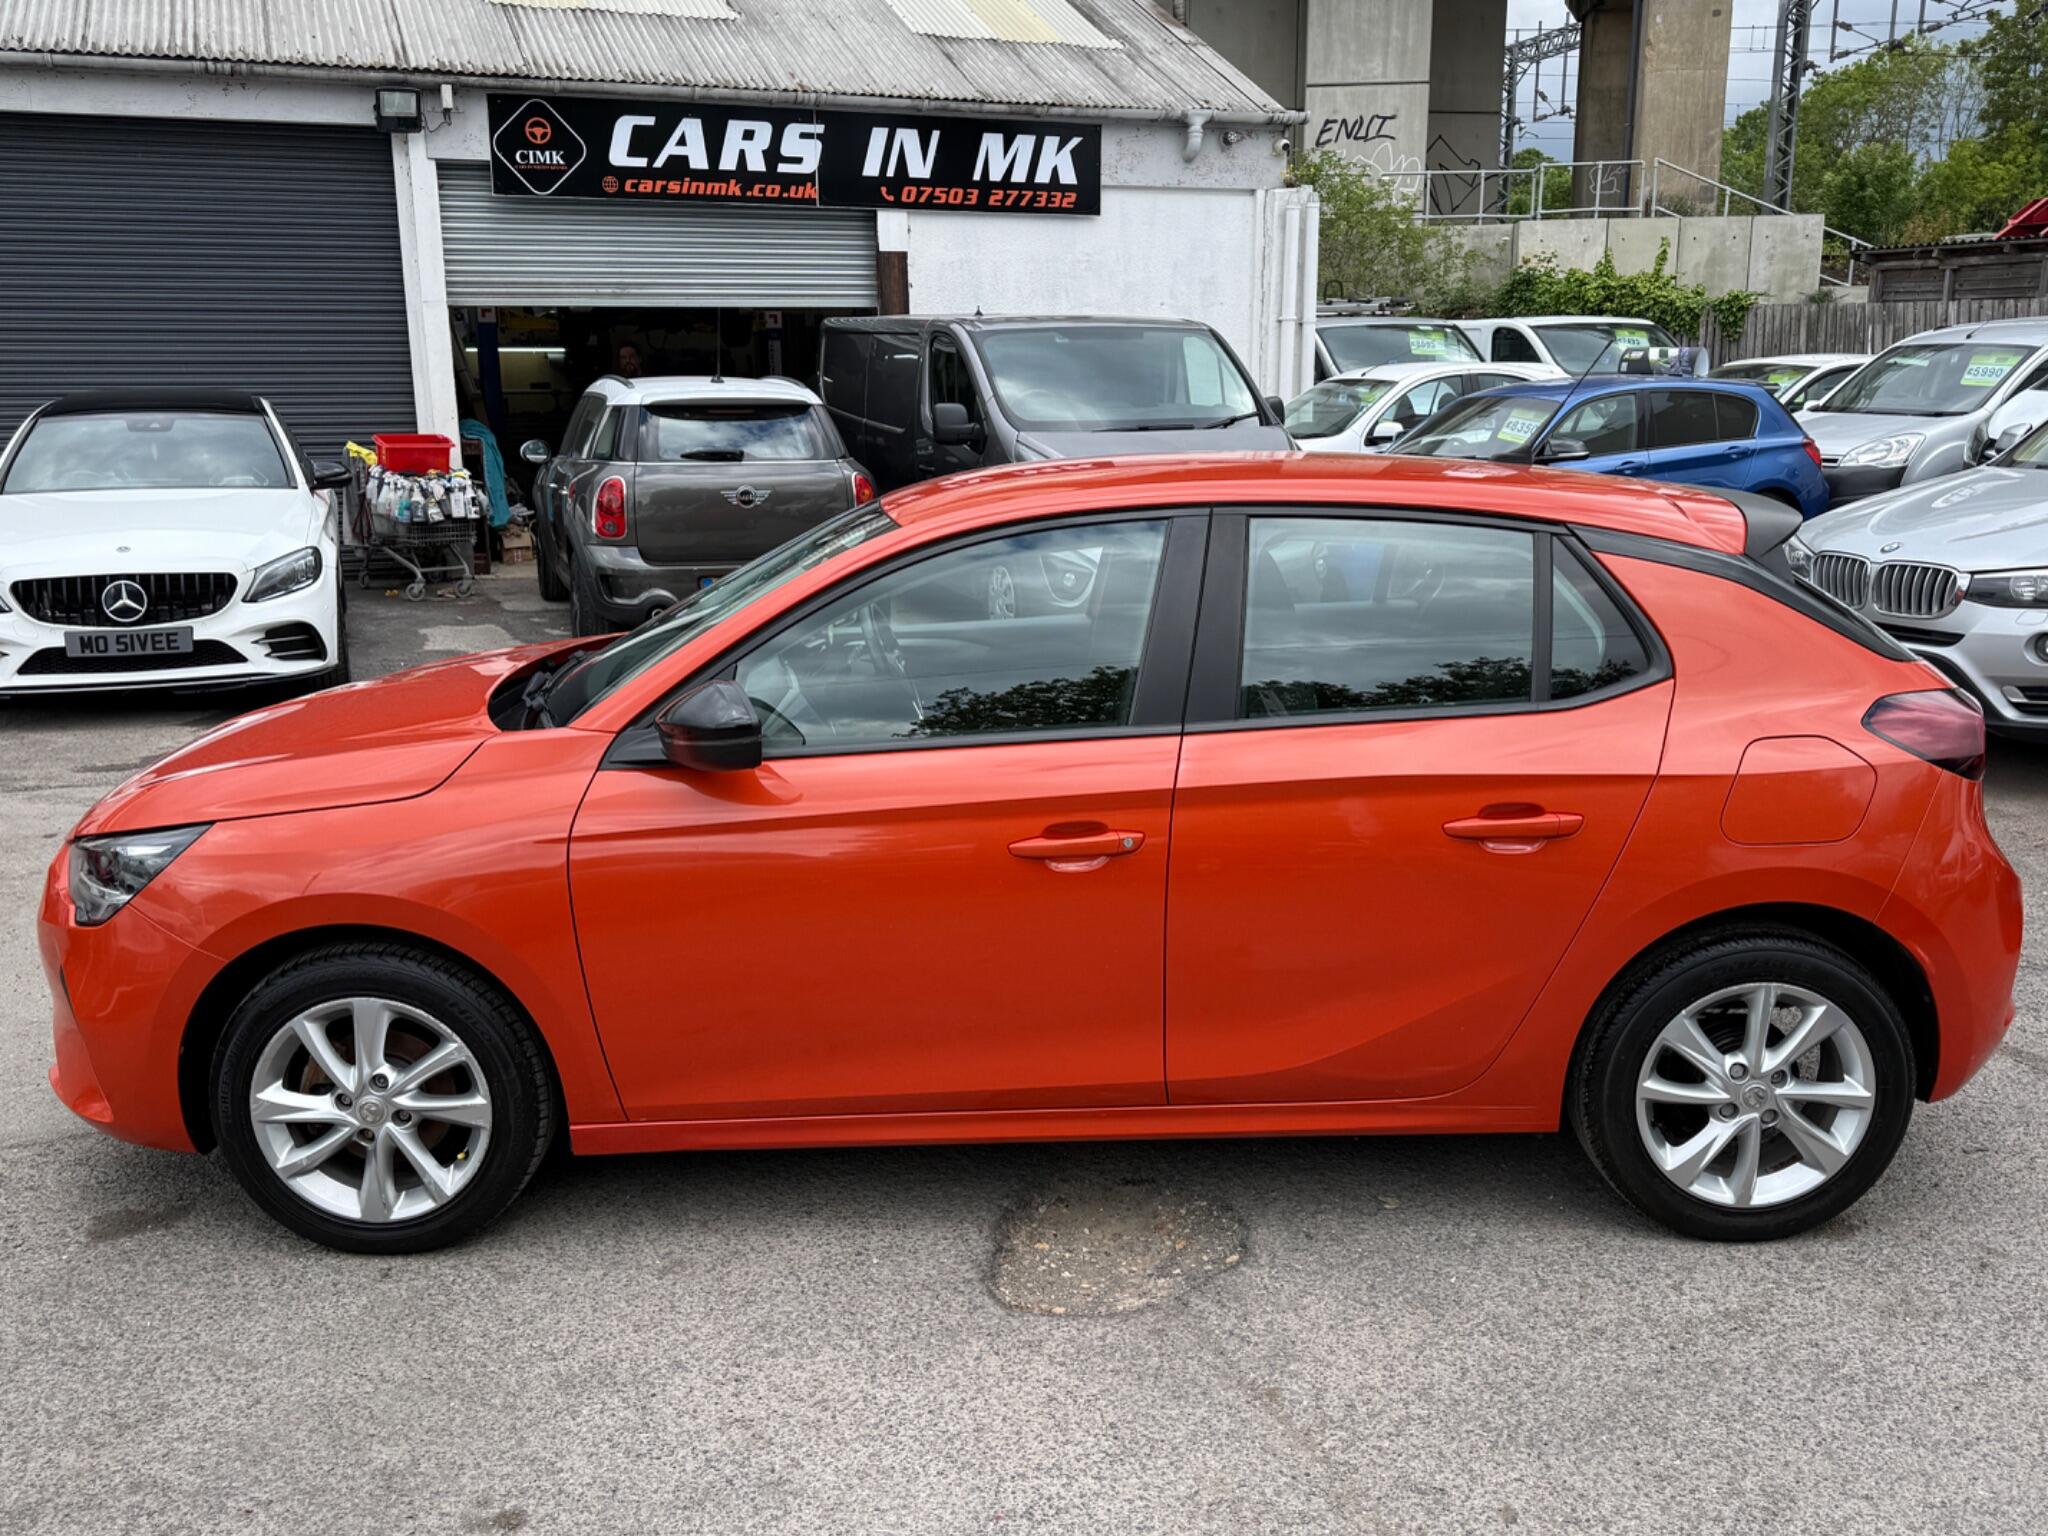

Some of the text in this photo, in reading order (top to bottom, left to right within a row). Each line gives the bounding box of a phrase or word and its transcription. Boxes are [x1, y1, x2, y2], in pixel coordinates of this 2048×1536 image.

[515, 149, 566, 165] CIMK
[608, 114, 1084, 185] CARS IN MK
[624, 177, 818, 199] carsinmk.co.uk
[901, 185, 1078, 208] 07503 277332
